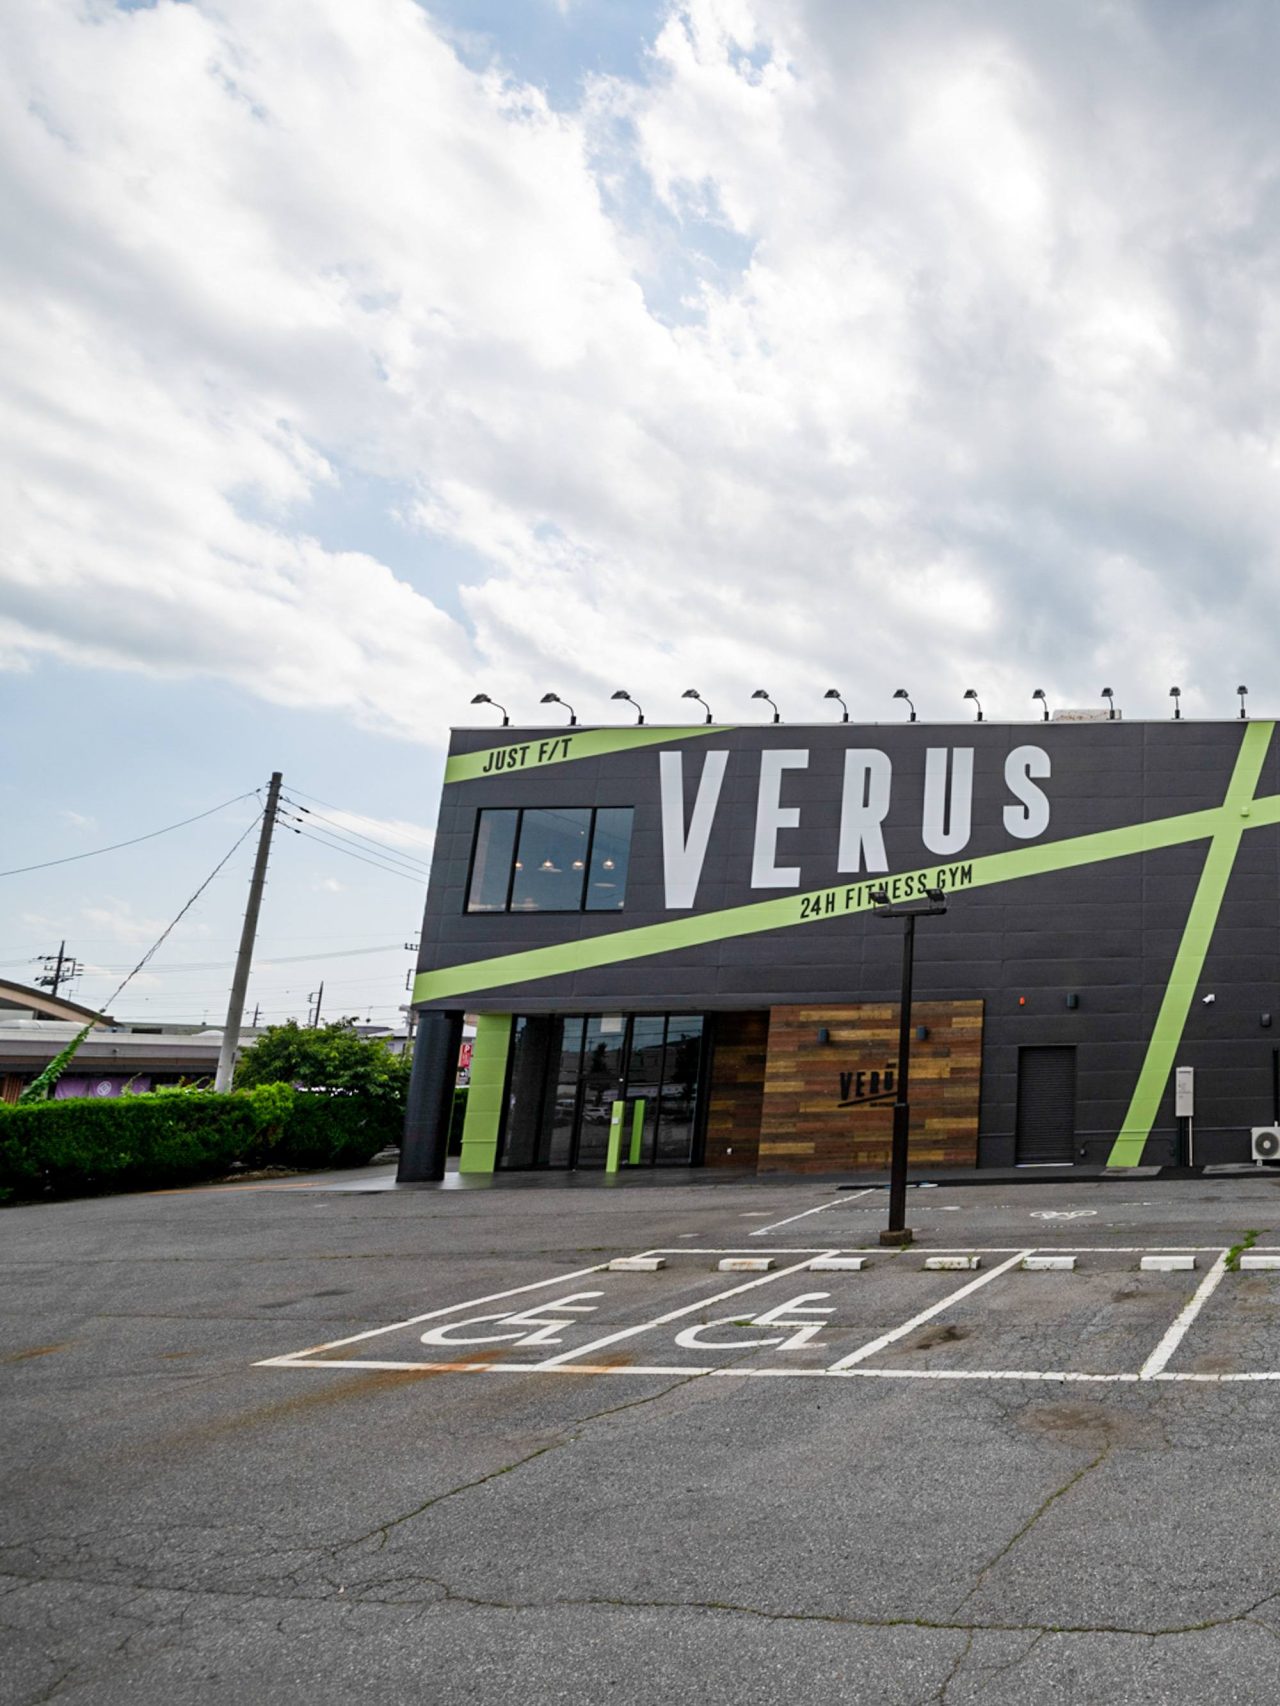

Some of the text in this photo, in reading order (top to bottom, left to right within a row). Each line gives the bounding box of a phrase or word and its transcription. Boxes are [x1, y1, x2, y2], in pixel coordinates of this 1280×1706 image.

[482, 745, 530, 773] JUST
[659, 745, 1052, 909] VERUS
[800, 892, 836, 919] 24H
[936, 864, 973, 890] GYM
